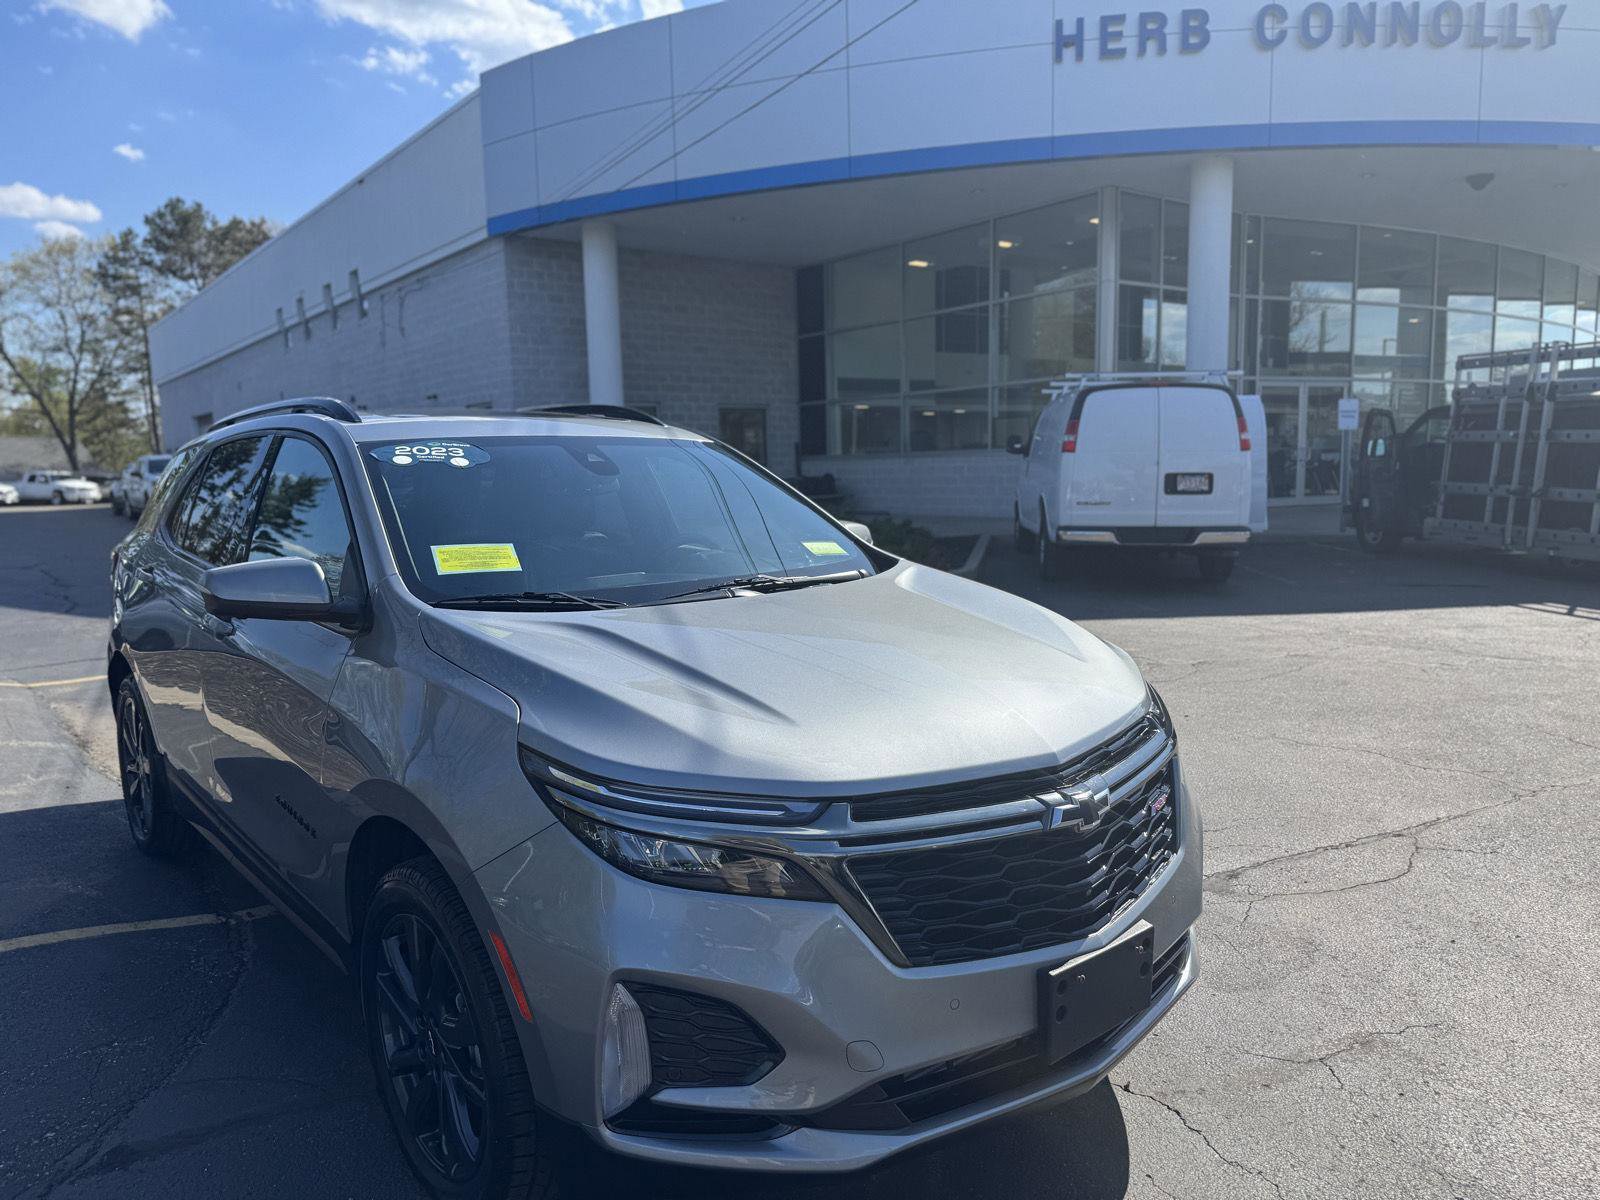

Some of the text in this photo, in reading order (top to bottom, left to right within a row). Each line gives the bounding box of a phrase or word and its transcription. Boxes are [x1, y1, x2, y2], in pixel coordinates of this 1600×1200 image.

[1054, 1, 1567, 63] HERB CONNOLLY
[394, 445, 465, 457] 2023
